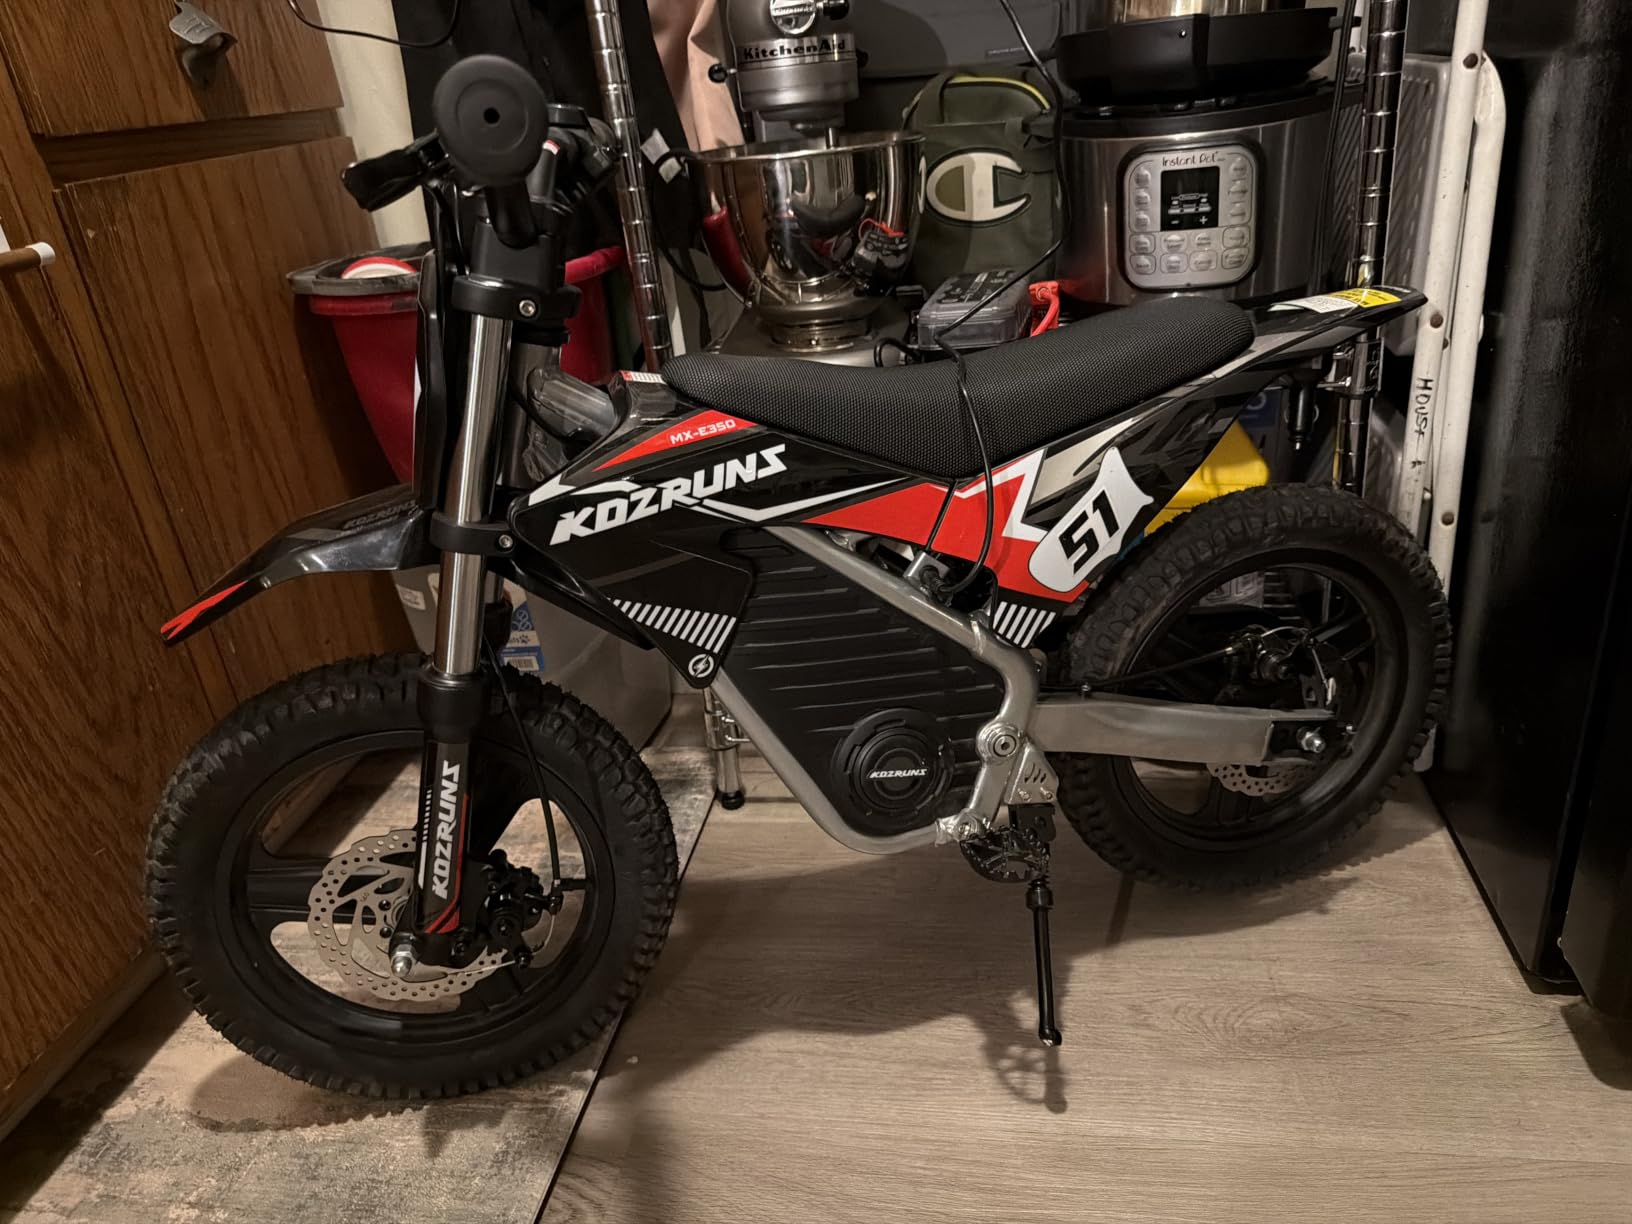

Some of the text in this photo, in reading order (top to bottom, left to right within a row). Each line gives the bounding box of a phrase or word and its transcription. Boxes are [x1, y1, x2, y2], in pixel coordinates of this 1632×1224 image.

[743, 38, 847, 60] KitchenAid
[1162, 153, 1197, 167] Instant
[669, 418, 736, 445] MX-E350
[549, 443, 788, 546] KOZRUNS
[1058, 489, 1120, 575] 51
[869, 768, 928, 779] KOZRUNS
[432, 759, 461, 900] KOZRUNS
